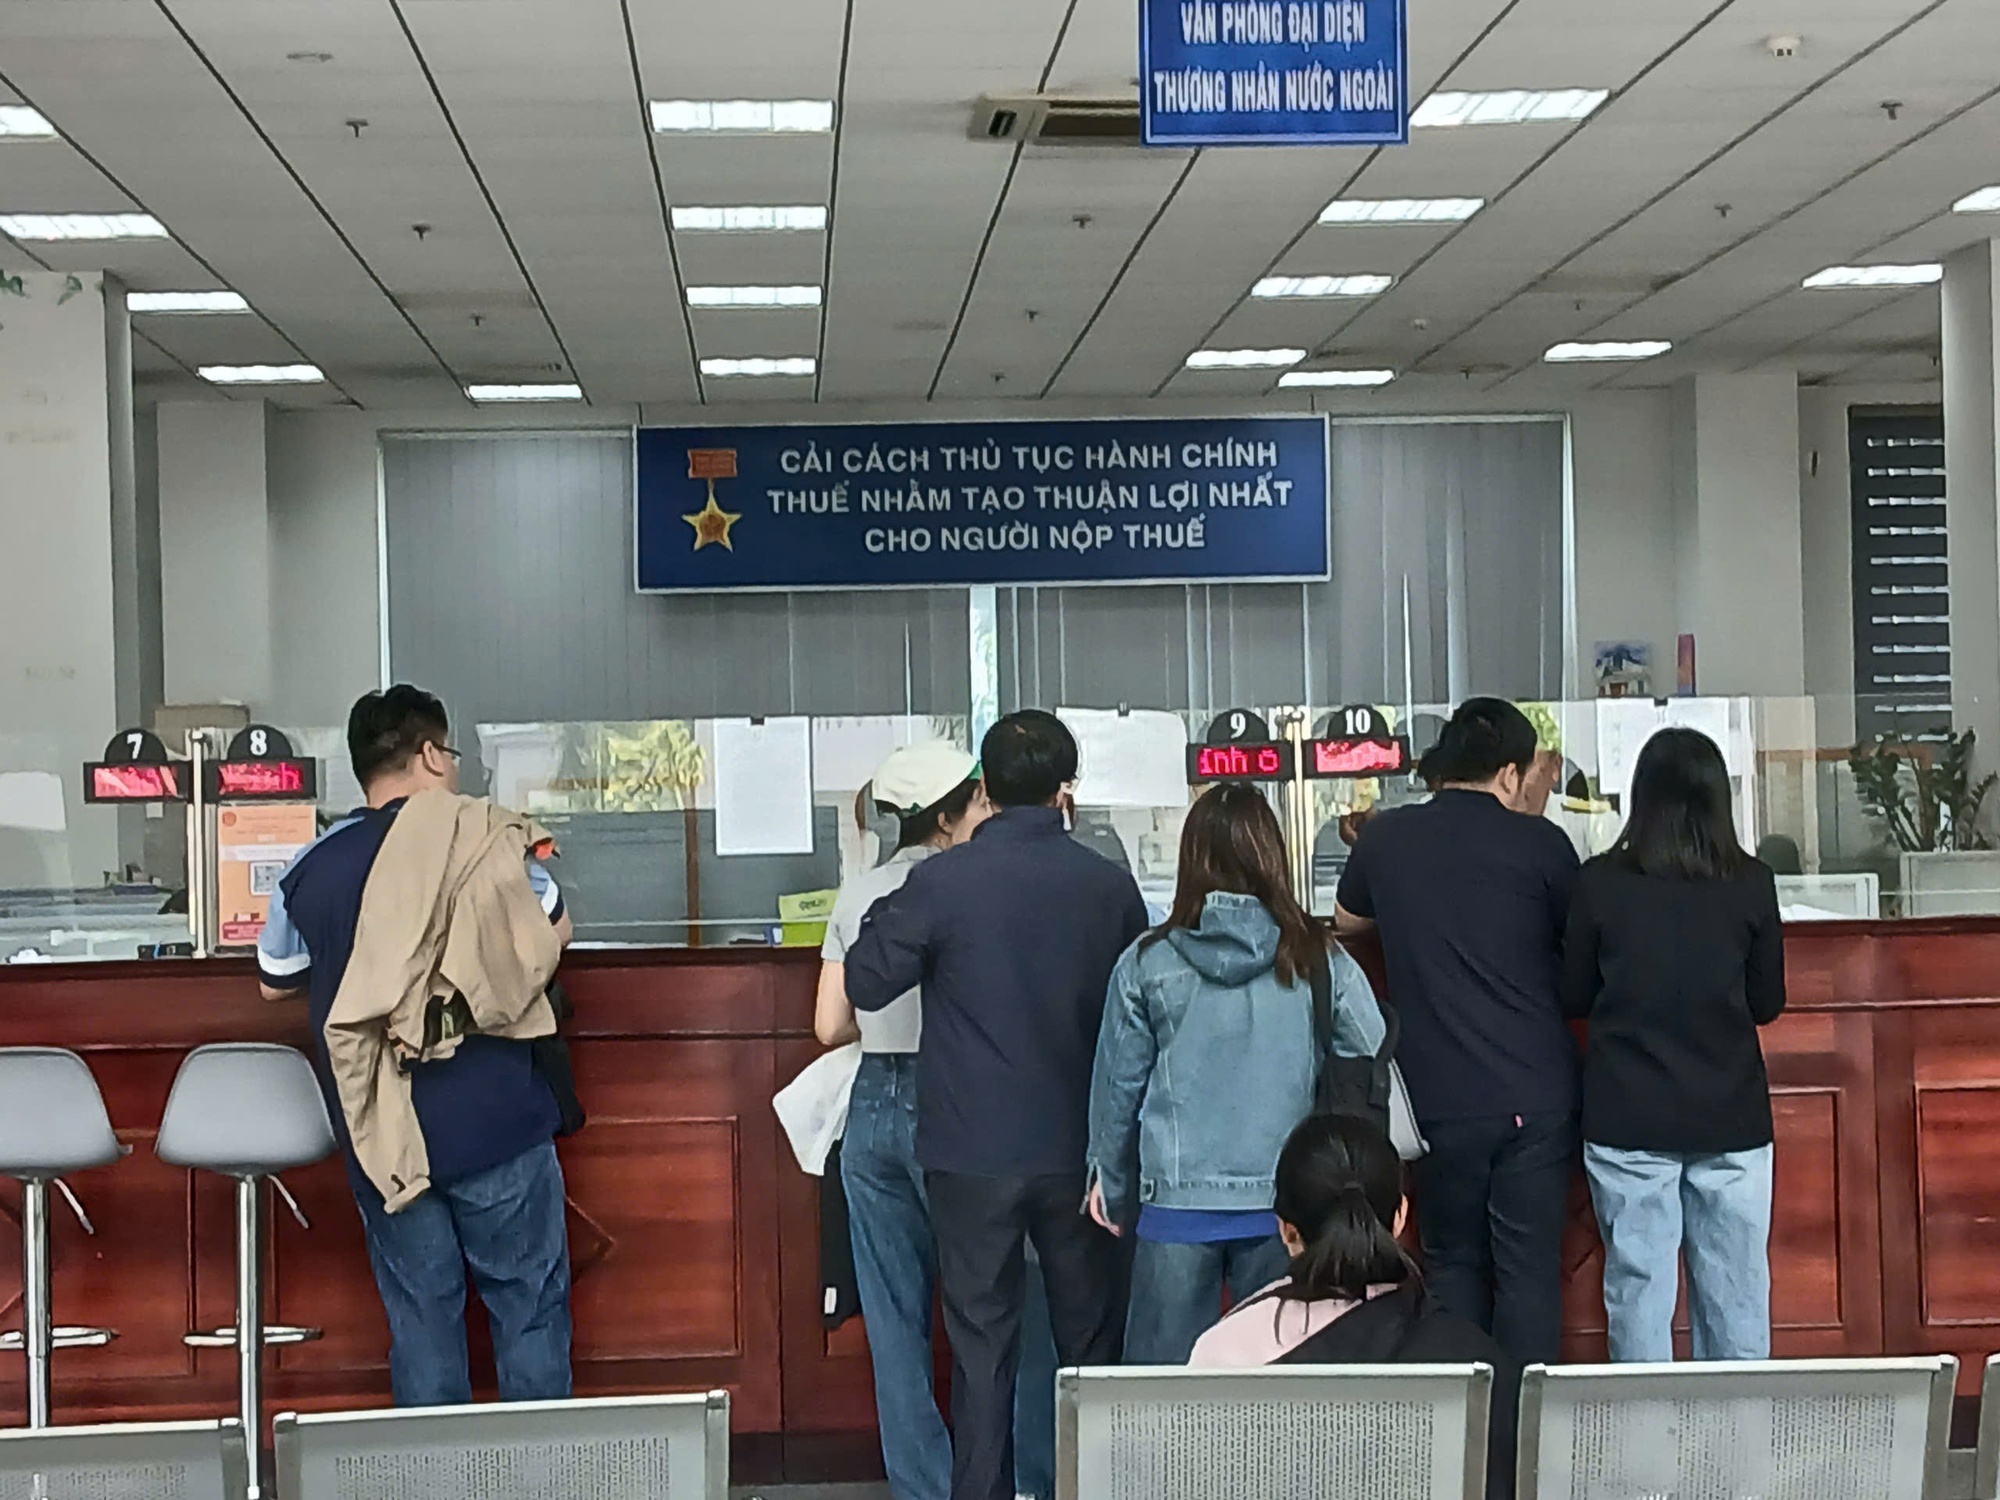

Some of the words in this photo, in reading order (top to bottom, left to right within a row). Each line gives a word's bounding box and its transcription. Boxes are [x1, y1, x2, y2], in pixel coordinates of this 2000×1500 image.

[1288, 1, 1319, 53] ĐẠI
[781, 440, 832, 473] CẢI
[843, 441, 930, 473] CÁCH
[940, 437, 1001, 471] THỦ
[1012, 445, 1074, 474] TỤC
[1085, 438, 1171, 470] HÀNH
[1182, 436, 1277, 468] CHÍNH
[767, 479, 850, 514] THUẾ
[861, 478, 950, 512] NHẰM
[961, 486, 1025, 515] TẠO
[1033, 478, 1138, 514] THUẬN
[1150, 480, 1198, 512] LỢI
[1208, 471, 1293, 508] NHẤT
[865, 528, 931, 553] CHO
[941, 520, 1039, 551] NGƯỜI
[1050, 519, 1113, 554] NỘP
[1123, 513, 1206, 549] THUẾ
[1230, 712, 1246, 739] 9
[1345, 708, 1371, 735] 10
[126, 732, 144, 759] 7
[249, 729, 268, 756] 8
